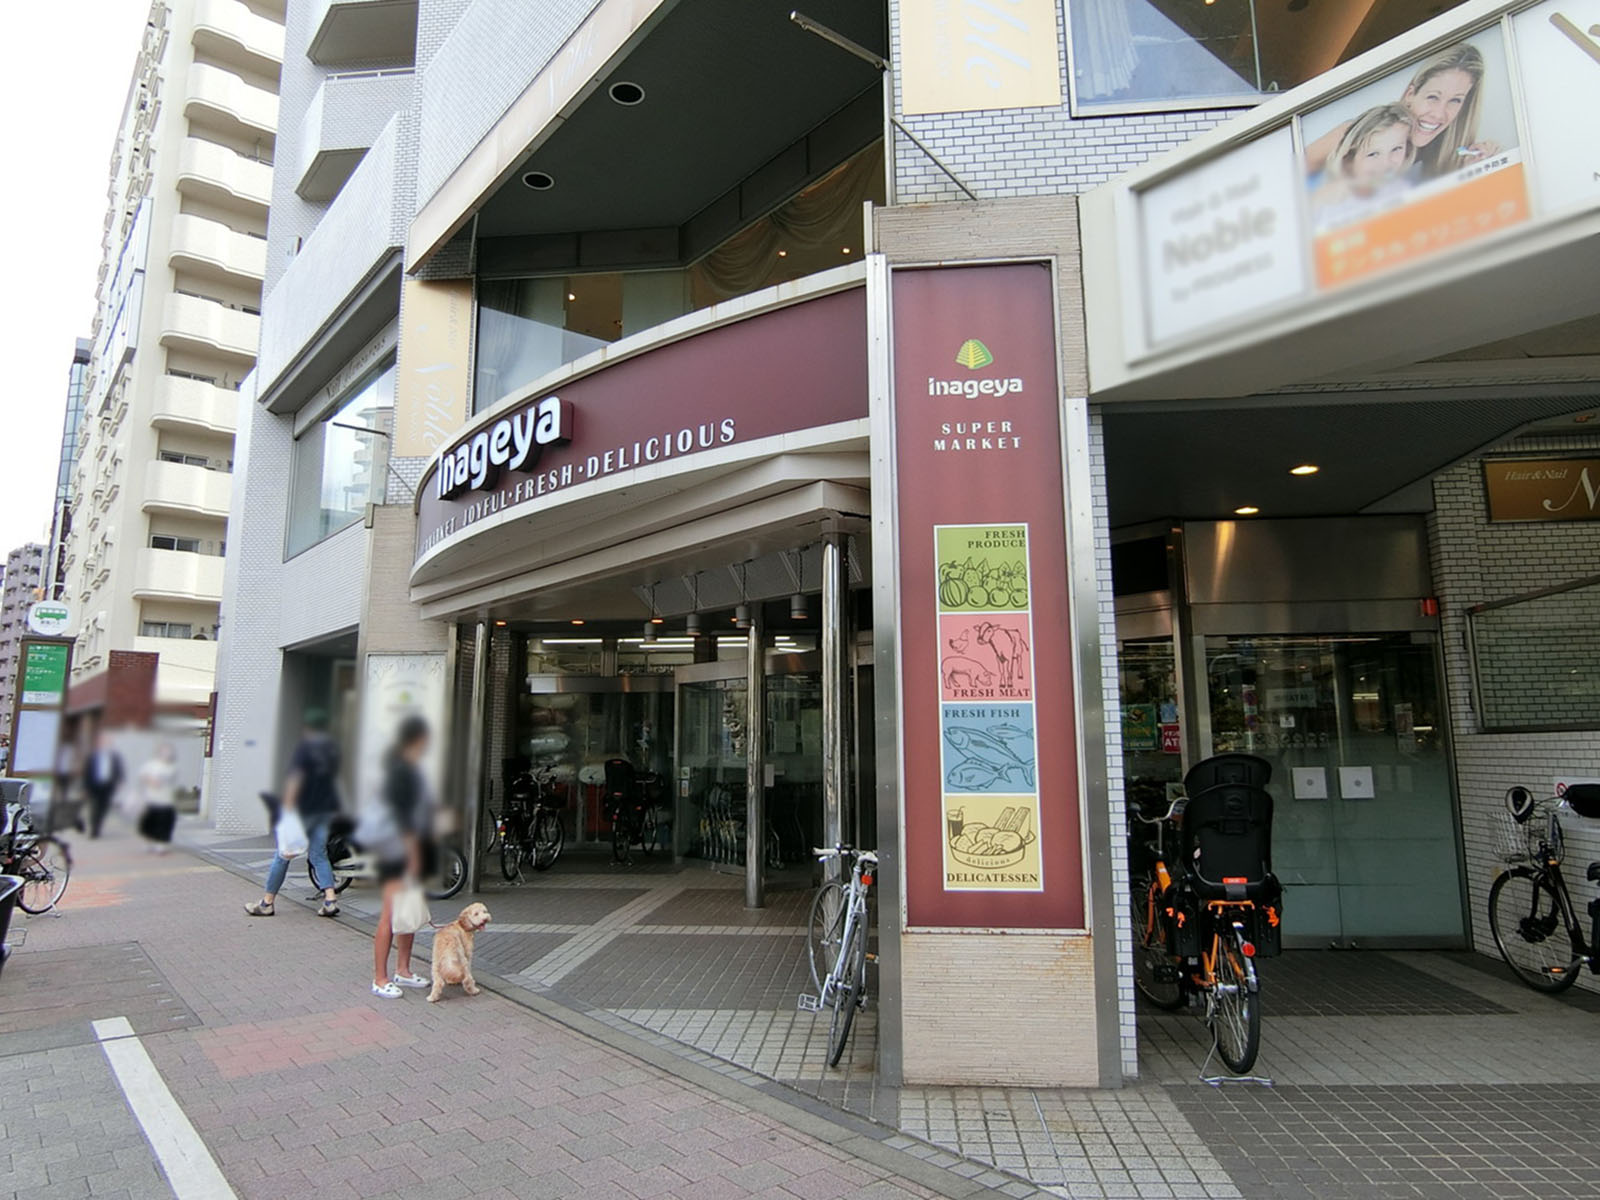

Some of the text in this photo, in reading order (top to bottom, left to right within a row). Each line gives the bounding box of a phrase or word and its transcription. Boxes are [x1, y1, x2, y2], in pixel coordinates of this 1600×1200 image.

[928, 377, 1023, 399] inageya
[941, 421, 1012, 435] SUPER
[436, 396, 562, 500] inageya
[934, 436, 1021, 451] MARKET
[985, 530, 1026, 539] FRESH
[968, 539, 1026, 549] PRODUCE
[953, 688, 1031, 698] FRESH MEAT
[944, 708, 1020, 718] FRESH FISH
[1164, 737, 1180, 747] AT
[946, 872, 1038, 883] DELICATESSEN
